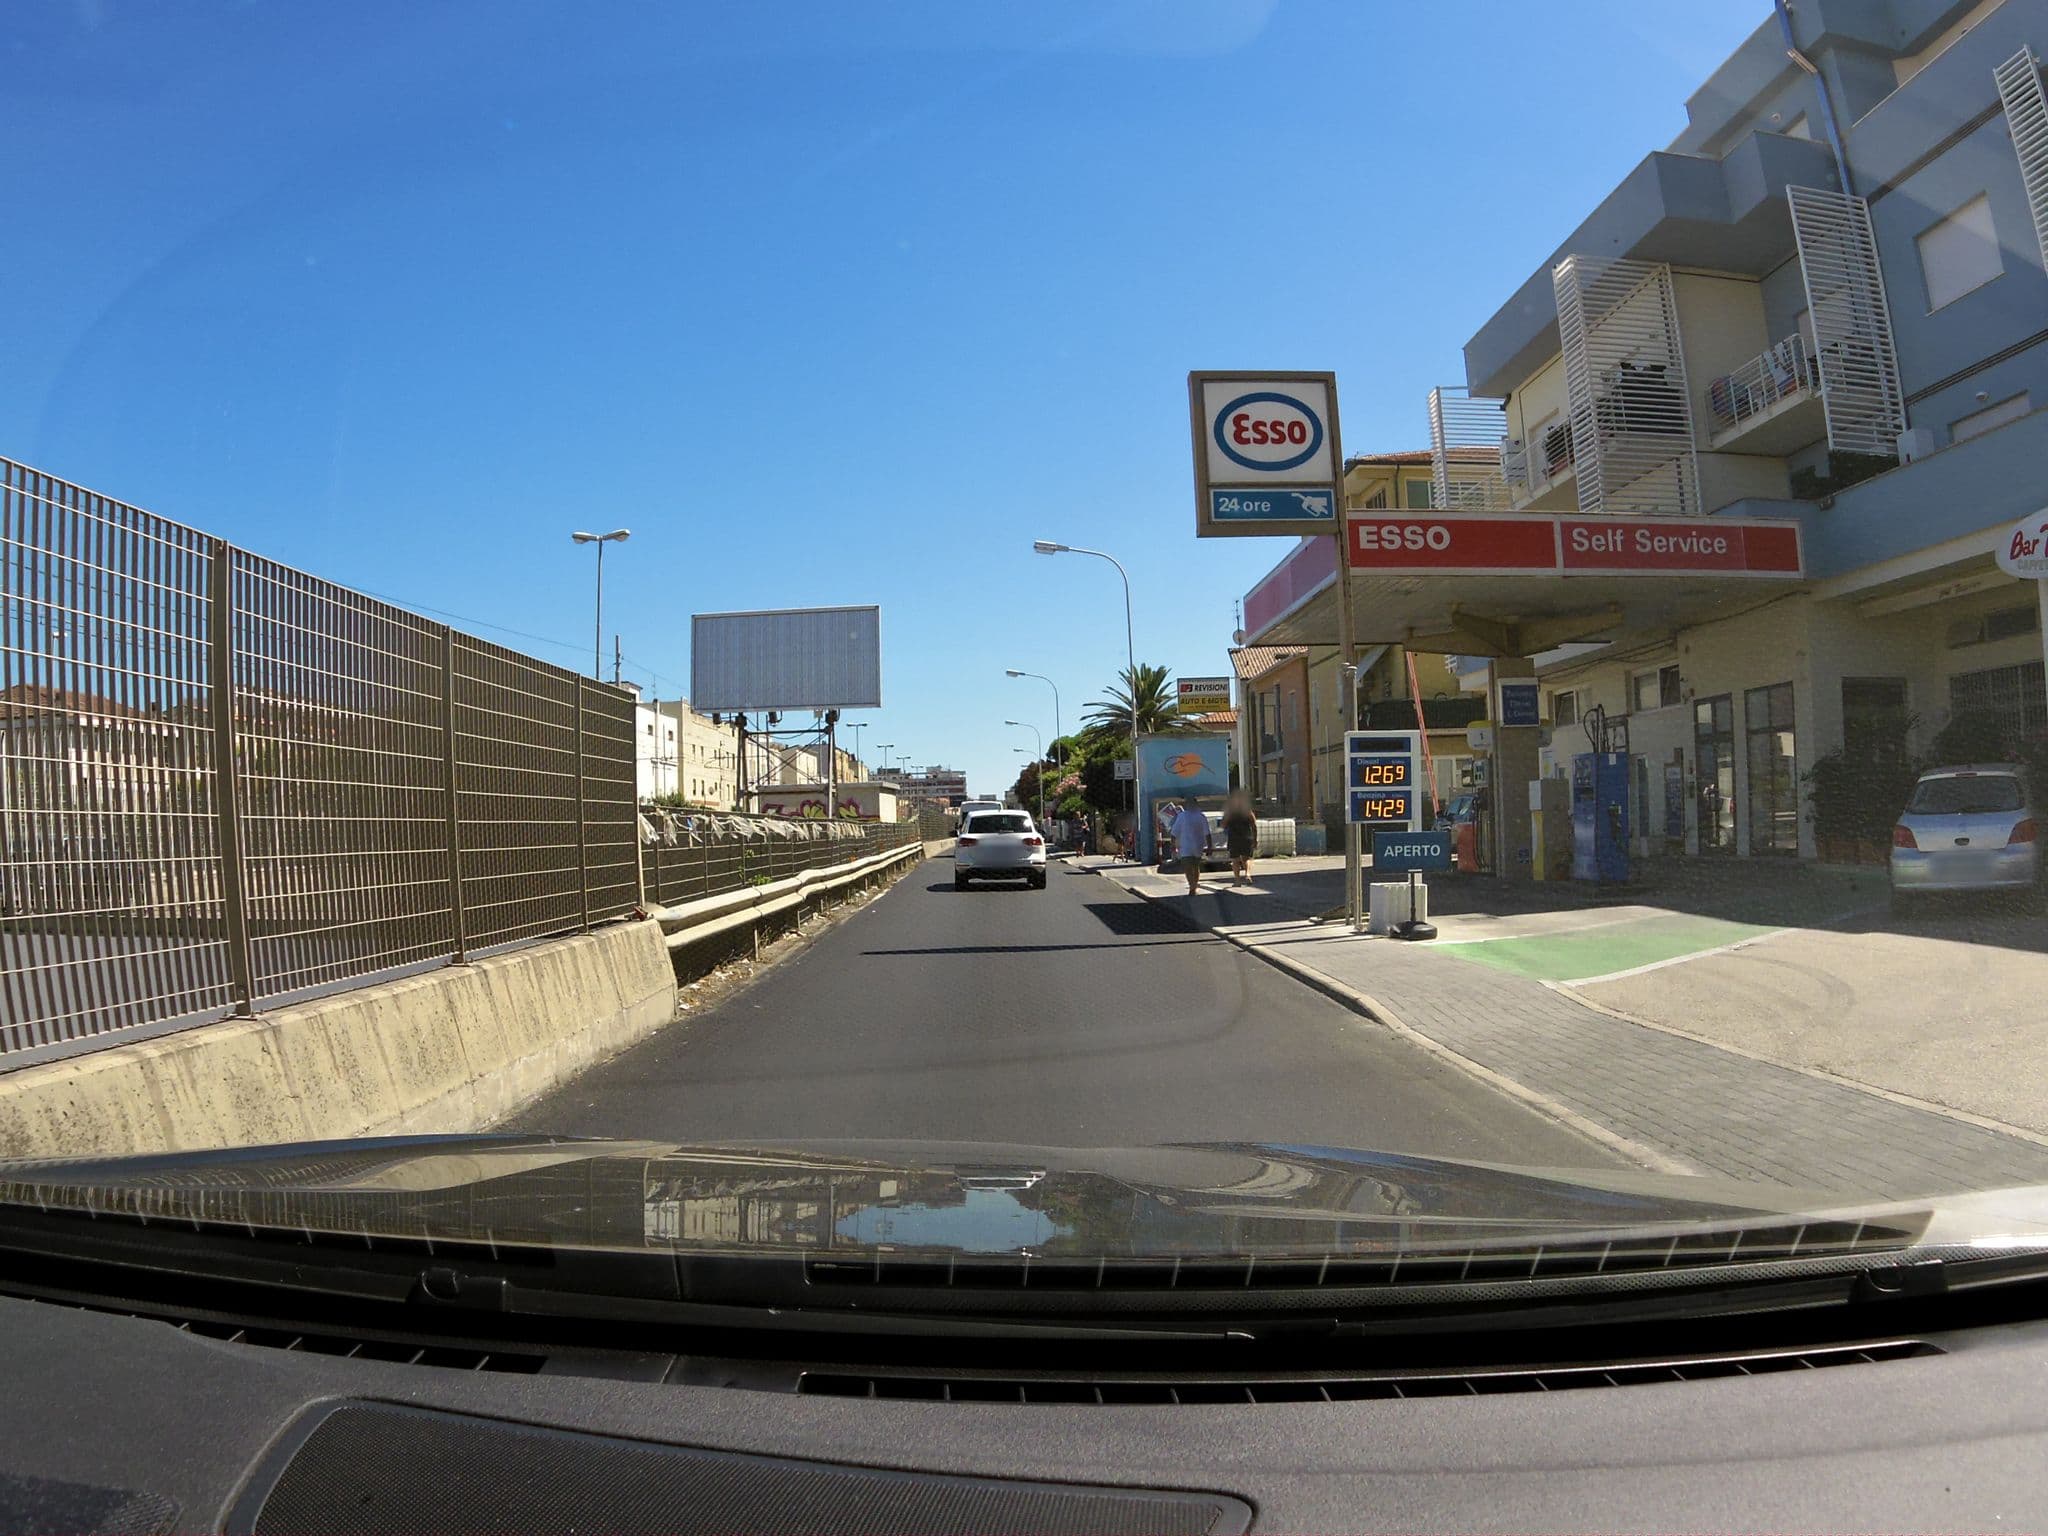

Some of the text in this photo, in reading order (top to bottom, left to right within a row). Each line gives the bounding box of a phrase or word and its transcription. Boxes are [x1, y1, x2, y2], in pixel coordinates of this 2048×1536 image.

[1232, 413, 1307, 445] Esso
[1218, 497, 1271, 512] 24 ore
[1358, 525, 1451, 551] ESSO
[1571, 527, 1728, 556] Self Service
[2009, 530, 2040, 560] Bar
[1364, 765, 1405, 784] 1.269
[1365, 799, 1405, 818] 1.429
[1383, 844, 1441, 857] APERTO
